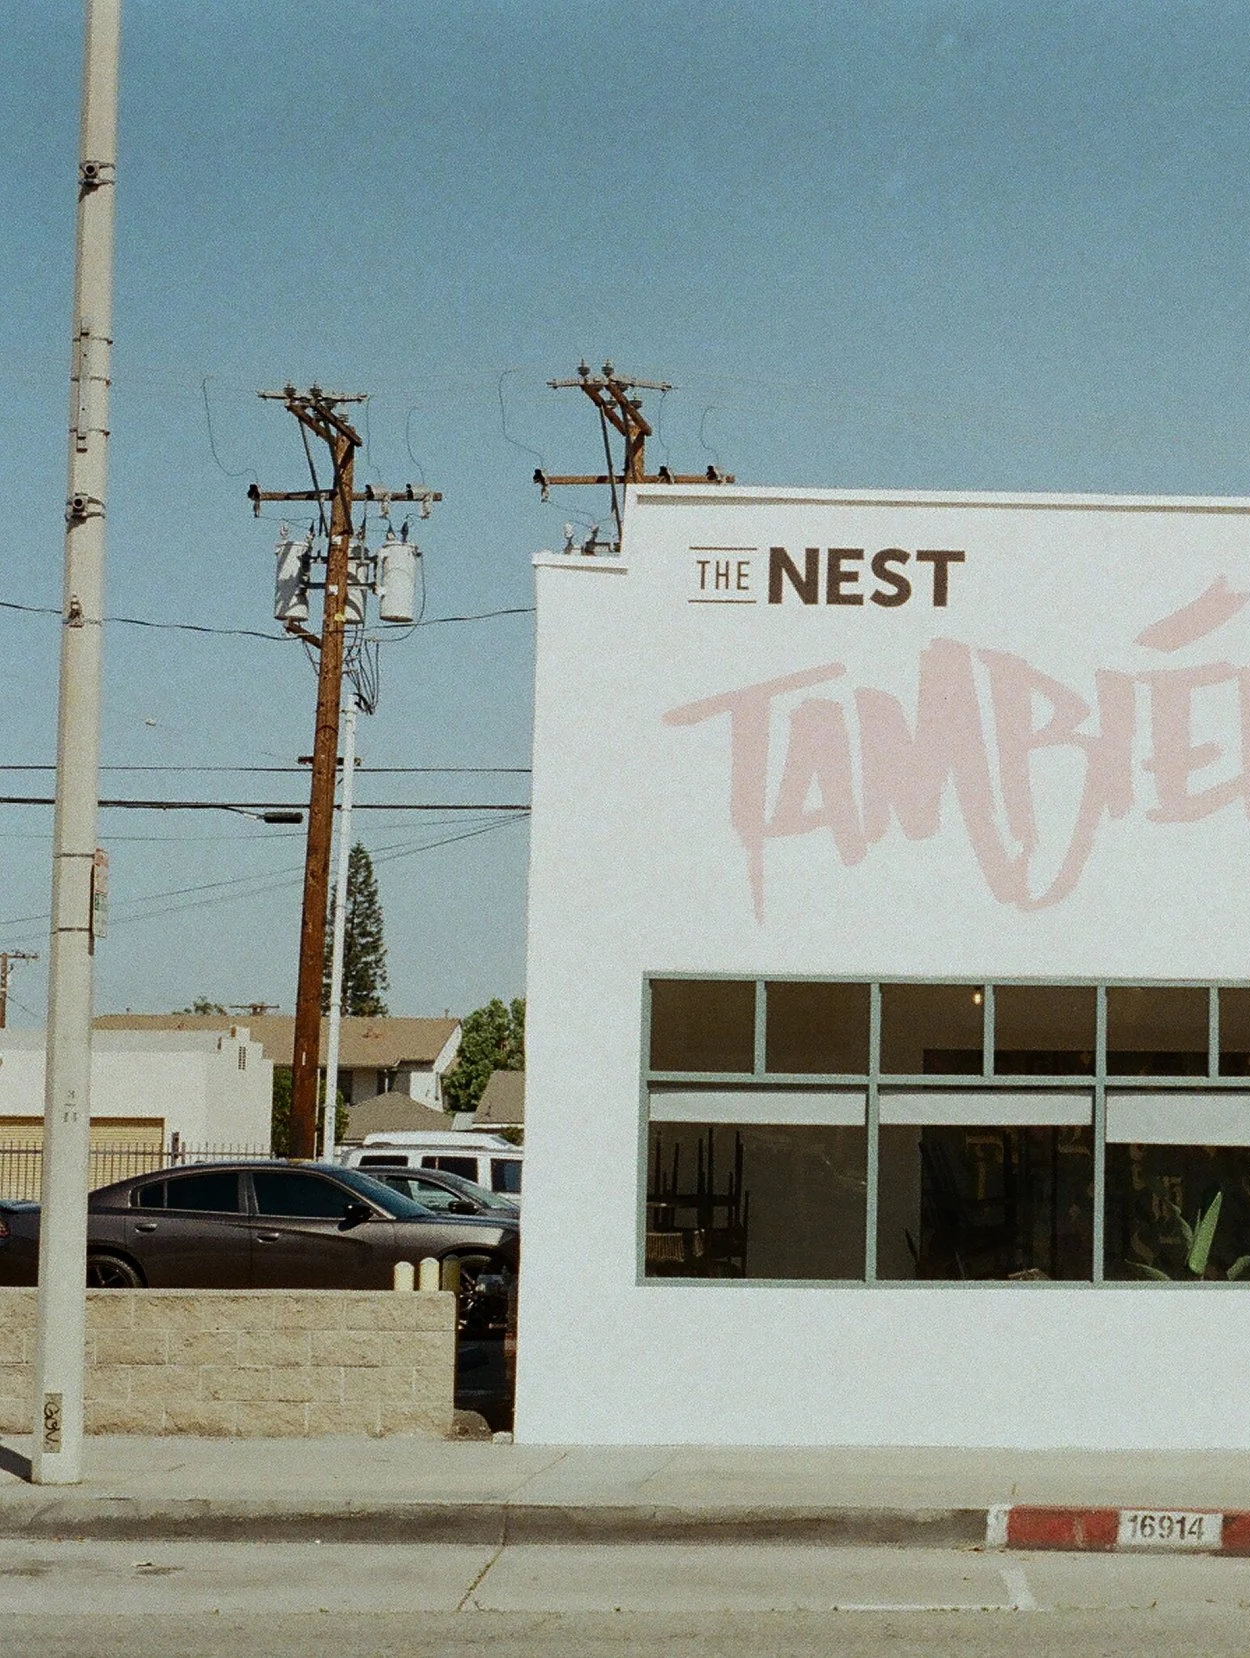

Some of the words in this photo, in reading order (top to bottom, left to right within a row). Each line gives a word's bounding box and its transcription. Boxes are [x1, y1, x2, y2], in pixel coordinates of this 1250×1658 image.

[697, 560, 750, 591] THE
[767, 547, 966, 607] NEST
[1129, 1515, 1205, 1540] 16914
